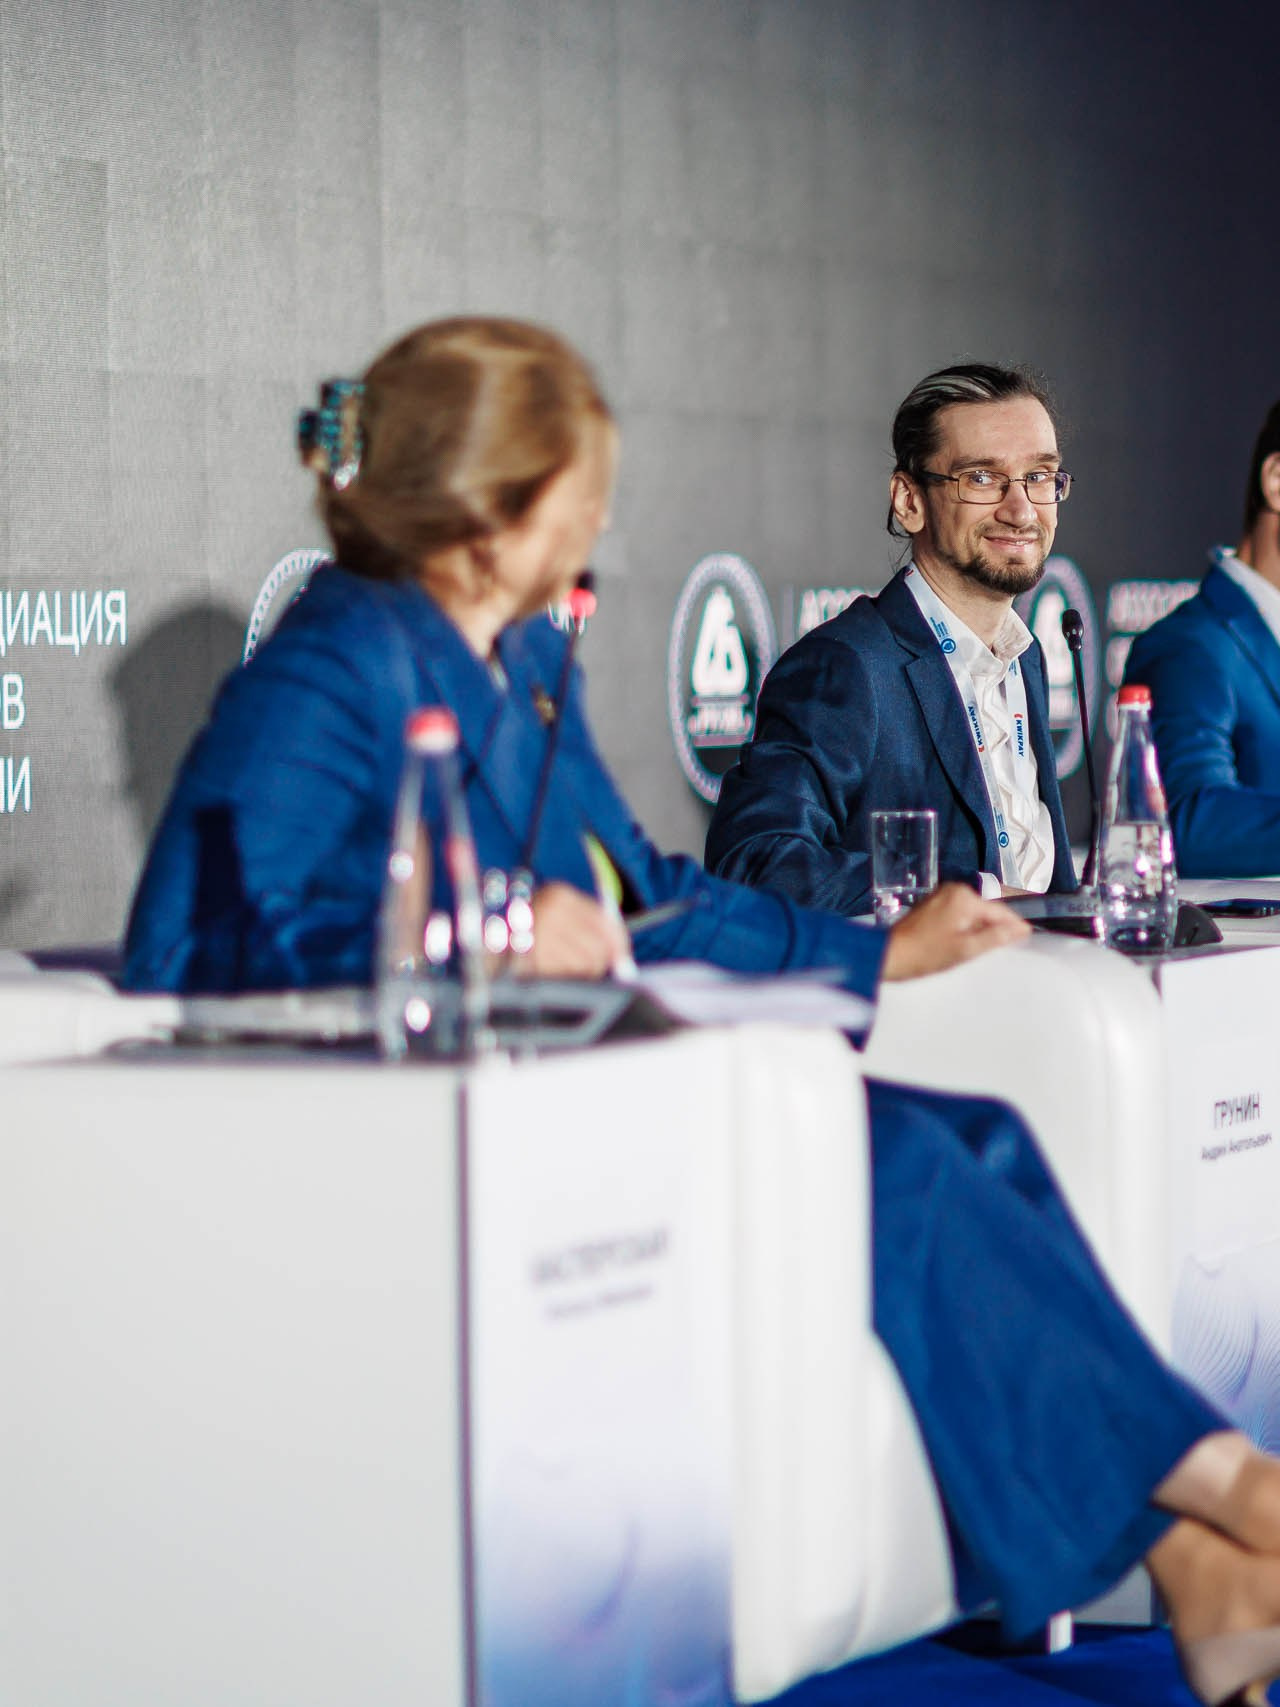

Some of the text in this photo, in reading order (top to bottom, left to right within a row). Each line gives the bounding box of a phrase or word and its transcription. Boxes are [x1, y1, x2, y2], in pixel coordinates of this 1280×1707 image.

[0, 590, 127, 656] ИАЦИЯ
[0, 672, 25, 730] В
[967, 705, 984, 746] KWIKPAY
[1015, 719, 1025, 757] KWIKPAY
[1213, 1092, 1261, 1129] ГРУНИН
